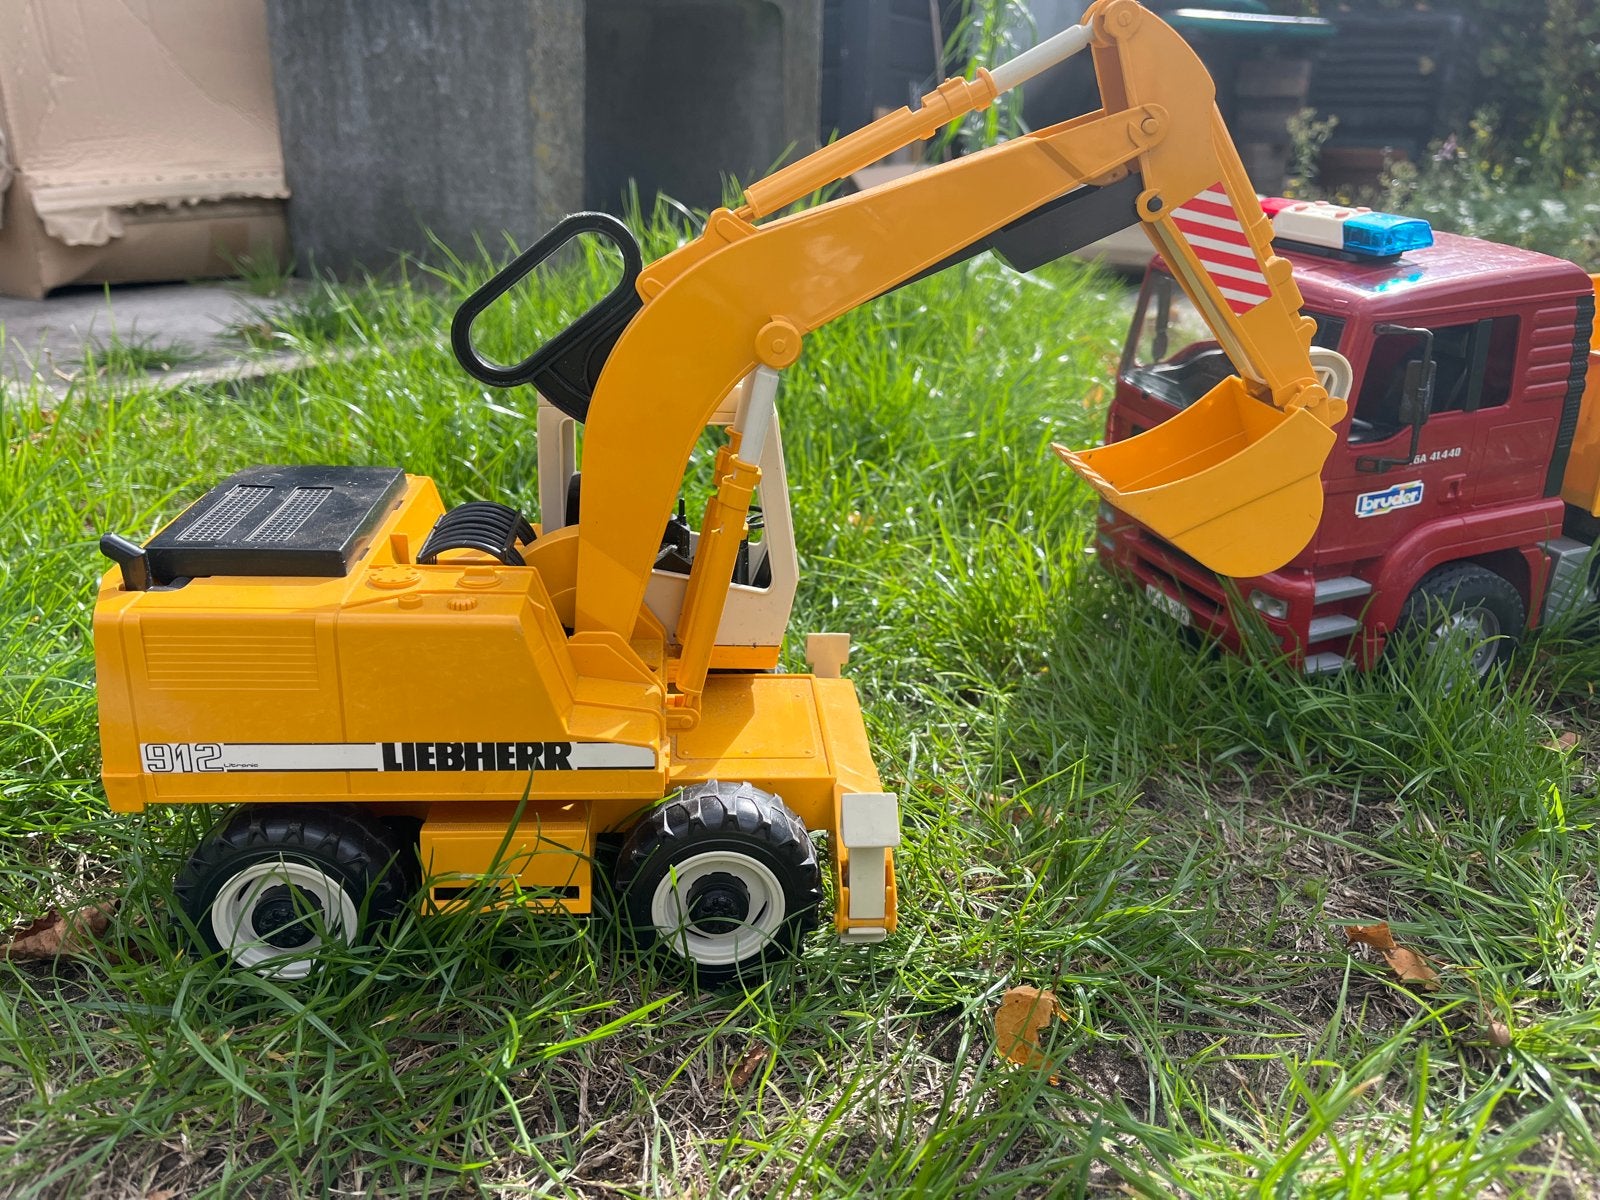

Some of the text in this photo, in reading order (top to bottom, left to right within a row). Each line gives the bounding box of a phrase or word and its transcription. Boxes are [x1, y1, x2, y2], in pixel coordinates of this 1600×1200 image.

[1408, 453, 1427, 465] GA
[1361, 490, 1419, 511] bruder
[145, 743, 224, 772] 912
[382, 742, 573, 771] LIEBHERR
